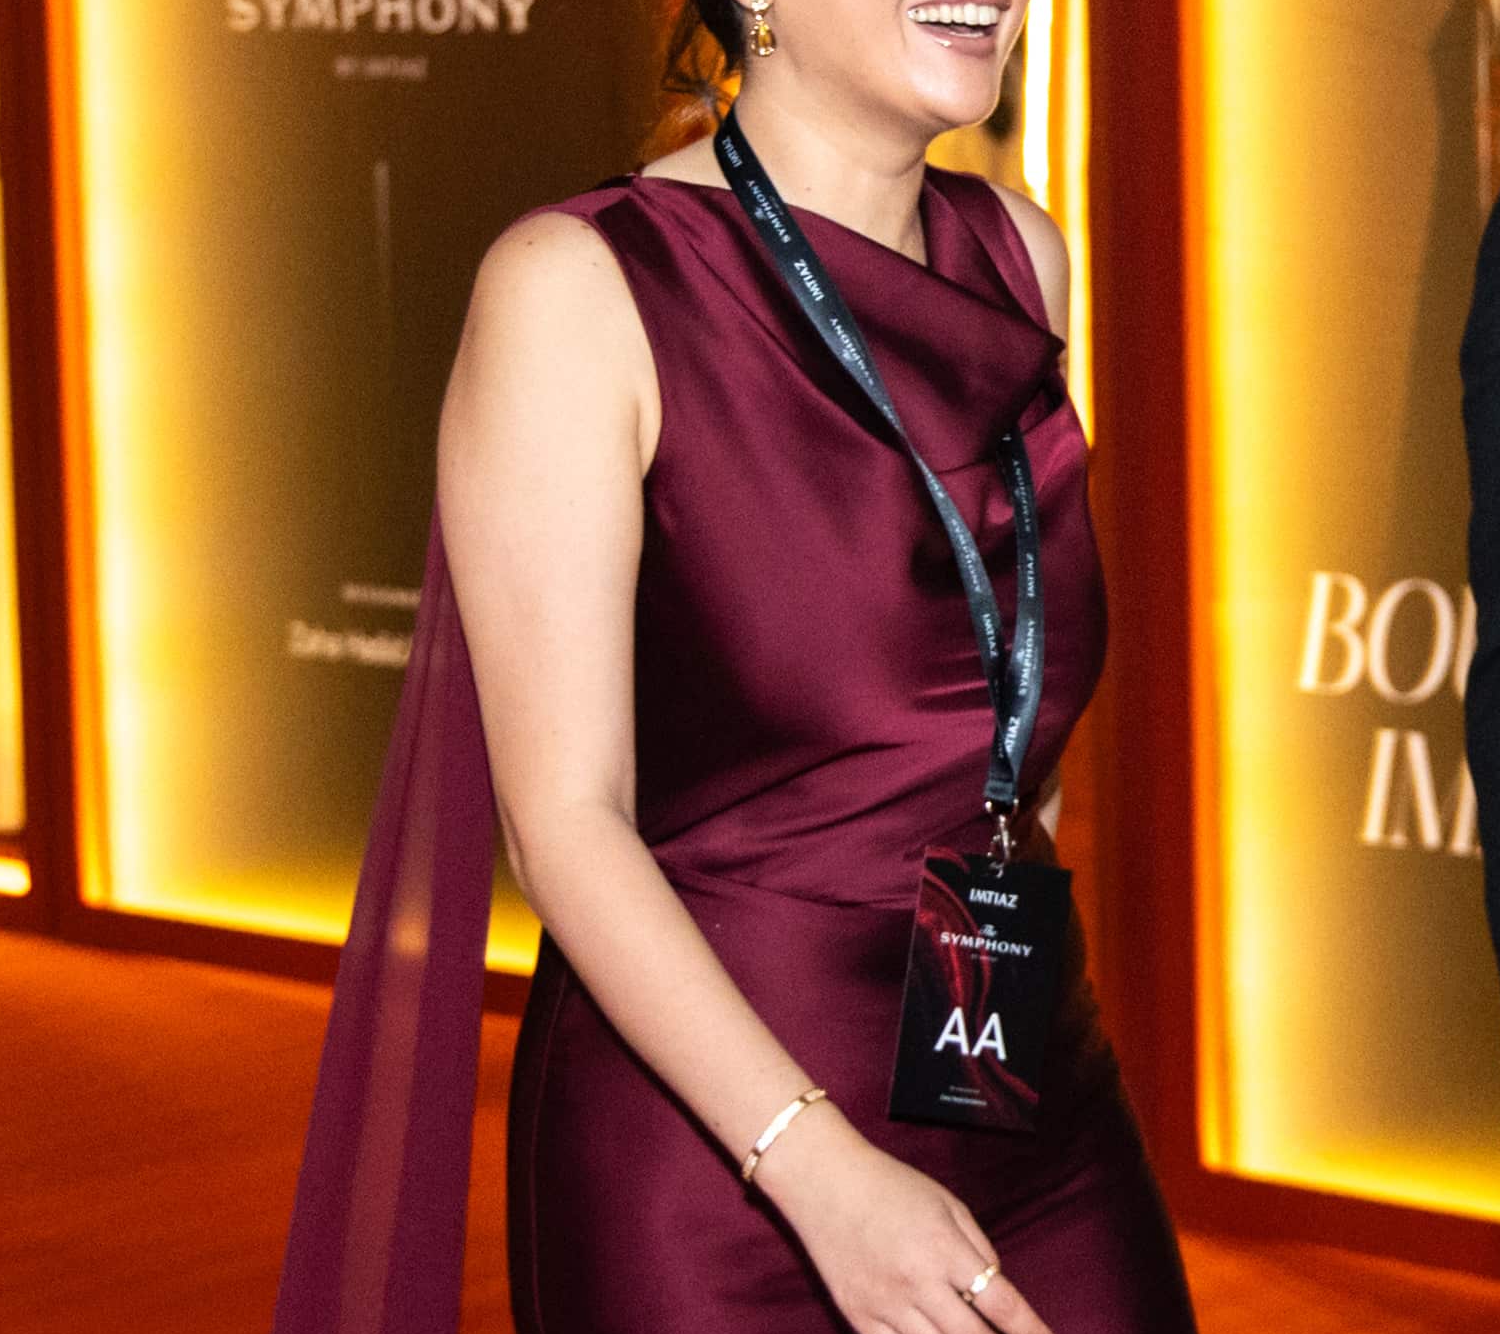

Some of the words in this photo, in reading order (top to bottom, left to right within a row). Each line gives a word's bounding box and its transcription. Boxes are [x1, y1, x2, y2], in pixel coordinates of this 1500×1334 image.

[793, 258, 826, 302] IMTIAZ
[1361, 727, 1484, 857] IM
[969, 887, 1019, 910] IMTIAZ
[940, 930, 1033, 958] SYMPHONY
[934, 1005, 1007, 1062] AA
